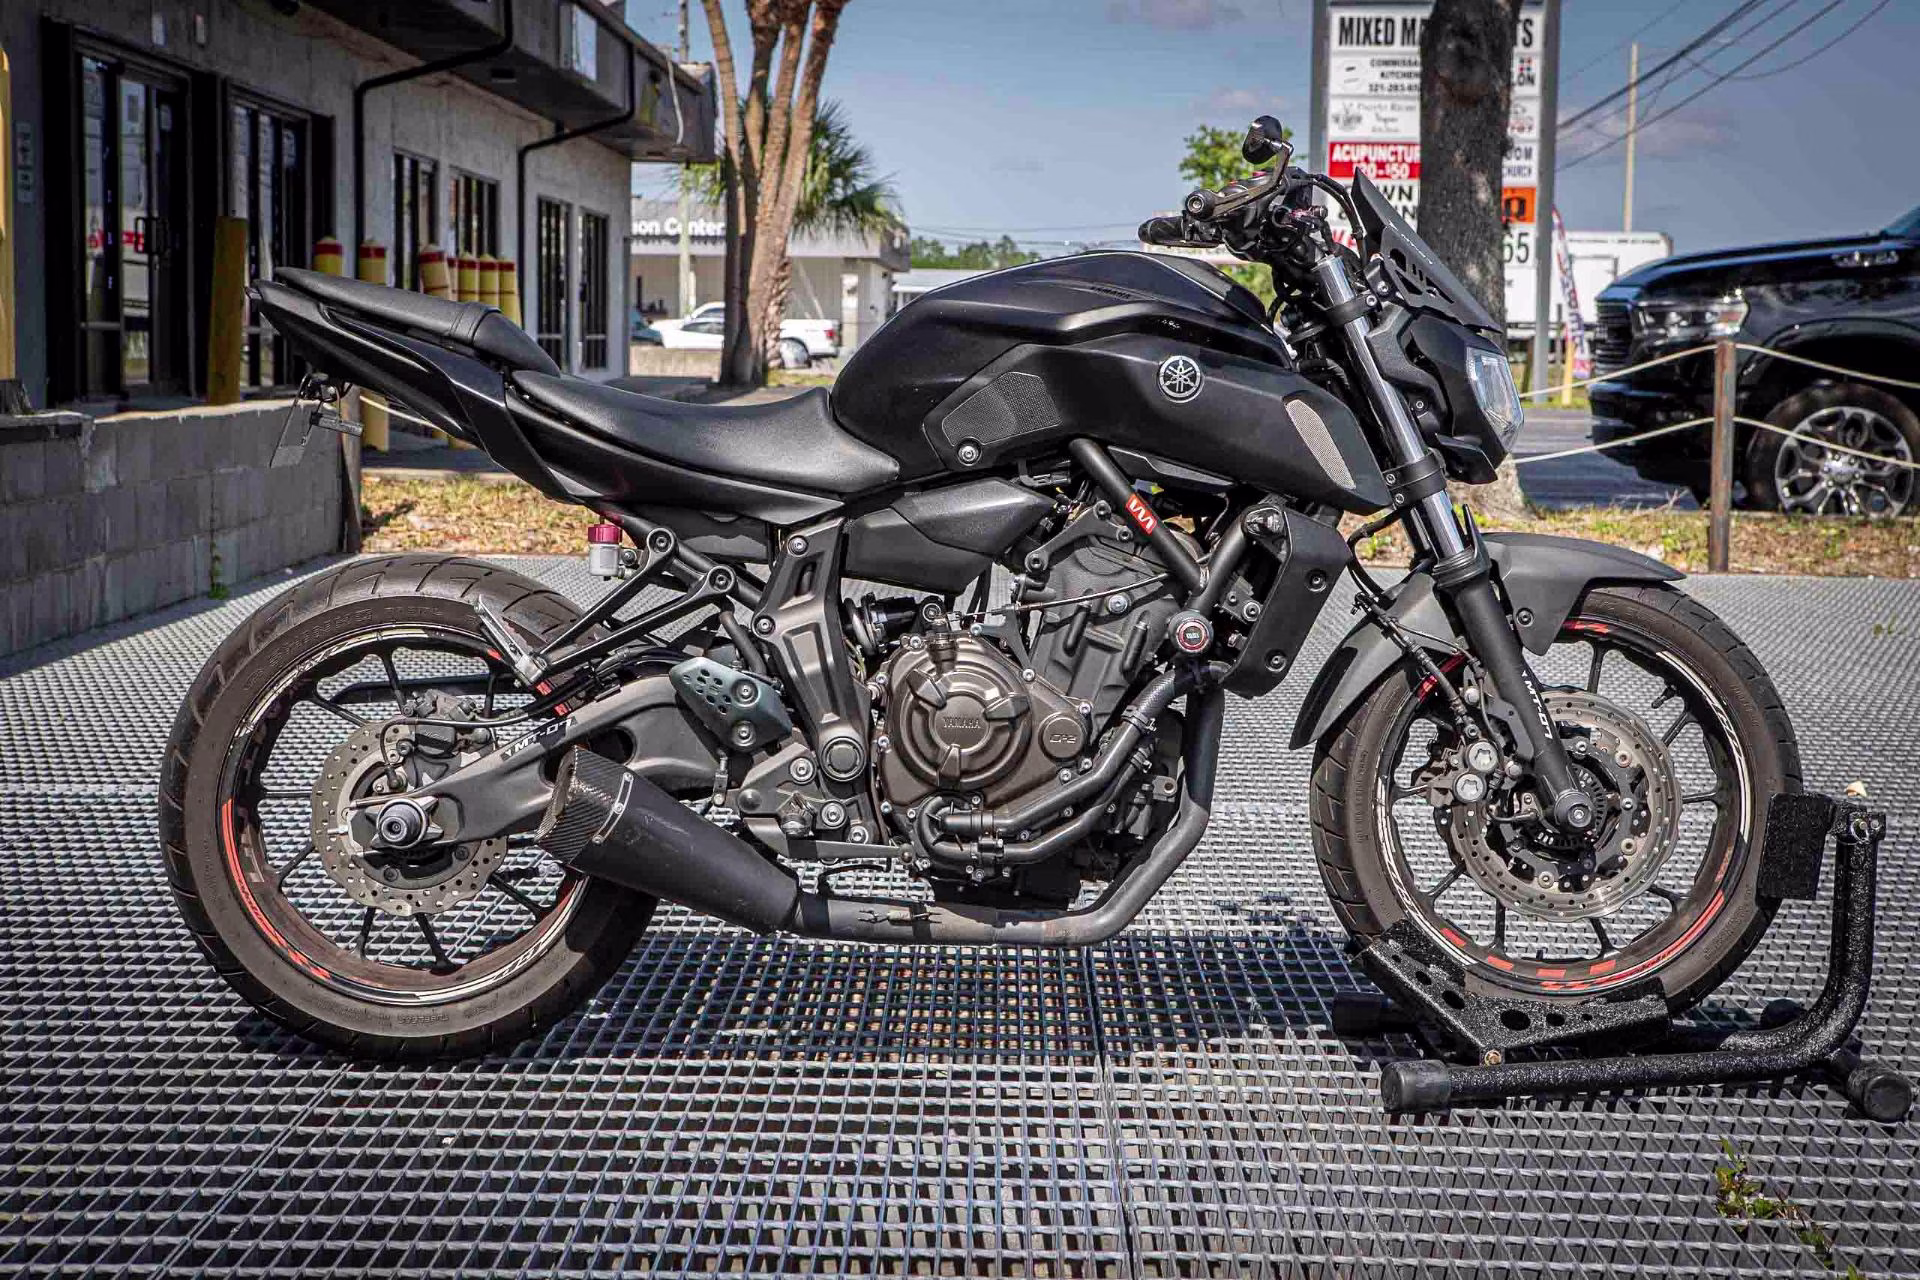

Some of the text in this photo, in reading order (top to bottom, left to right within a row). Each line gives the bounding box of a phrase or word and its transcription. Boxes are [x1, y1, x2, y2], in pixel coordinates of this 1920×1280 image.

[1339, 16, 1395, 46] MIXED
[1332, 144, 1420, 163] ACUPUNCTUR
[632, 220, 660, 236] ion
[1525, 681, 1553, 739] MT-07
[514, 718, 572, 751] MT-07
[943, 716, 982, 729] YAMAHA
